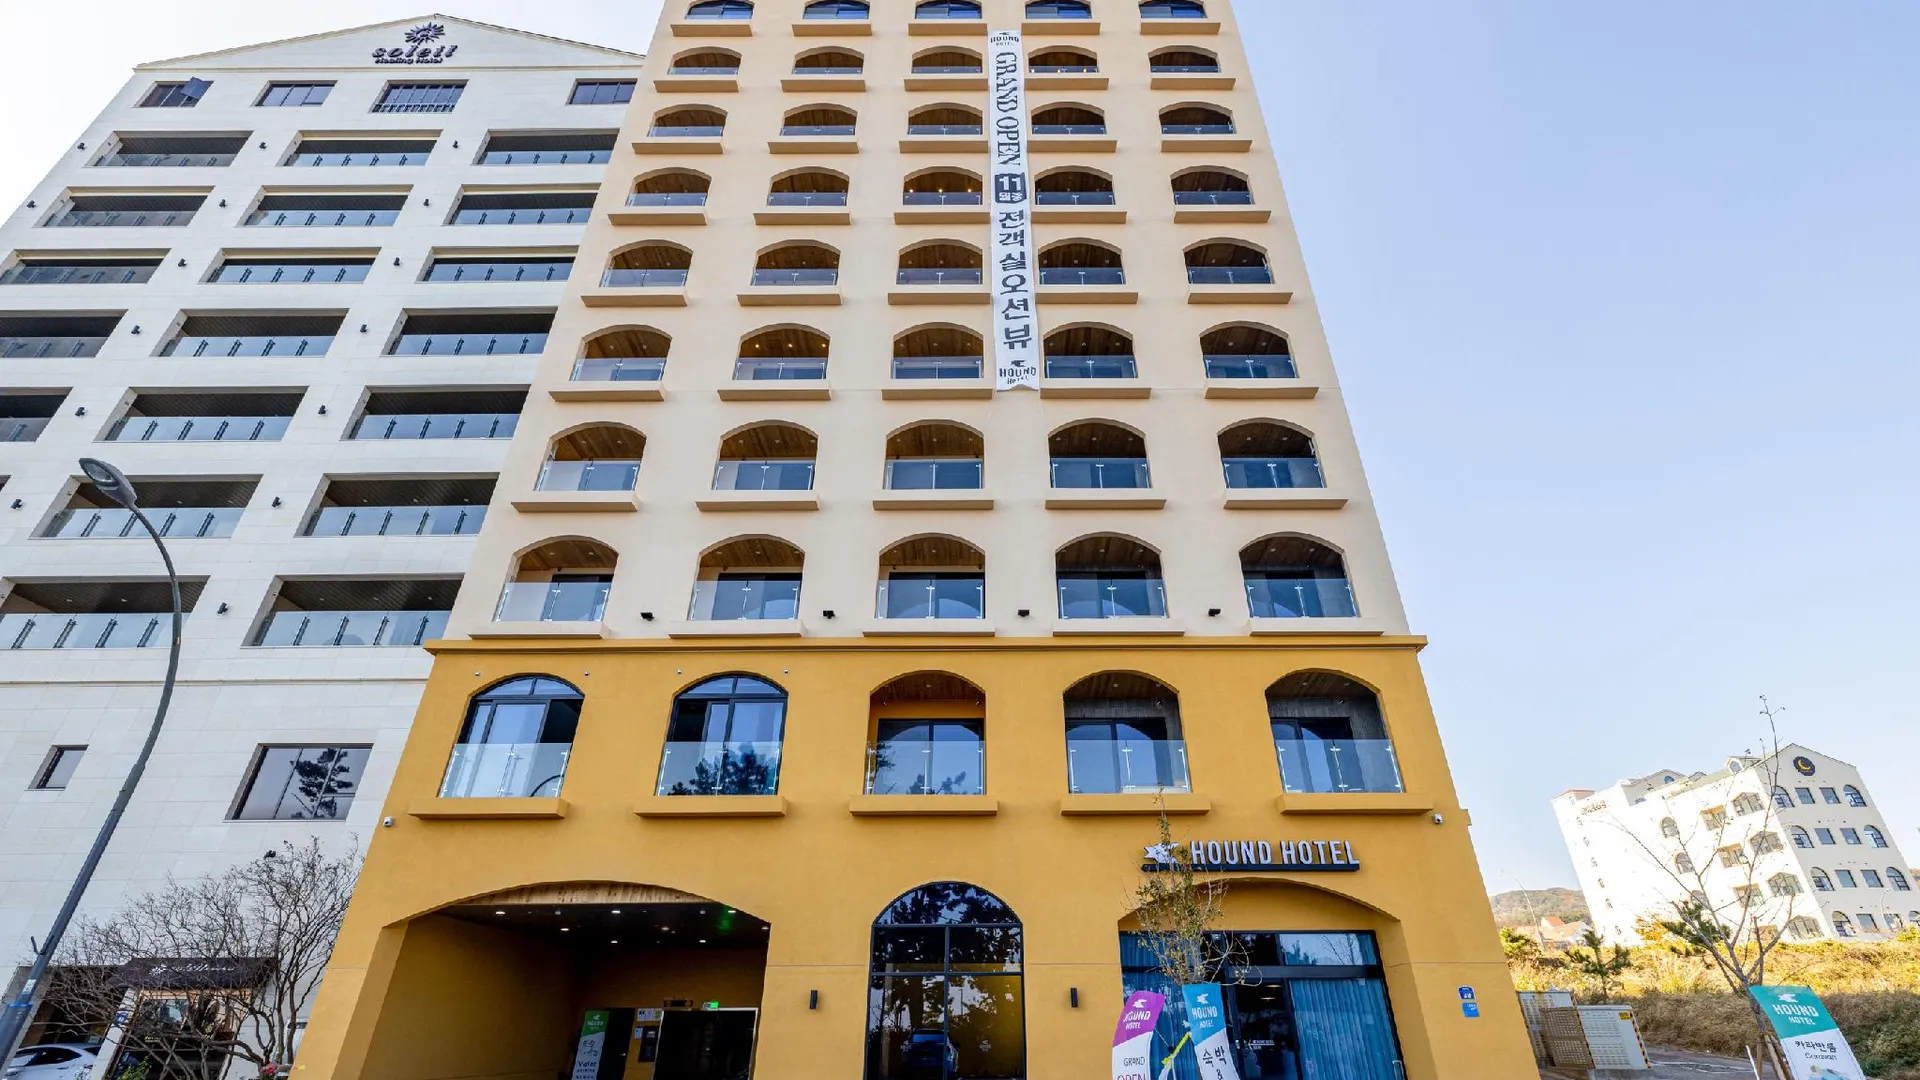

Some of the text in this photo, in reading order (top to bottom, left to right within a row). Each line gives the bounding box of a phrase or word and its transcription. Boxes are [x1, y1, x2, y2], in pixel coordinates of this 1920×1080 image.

[372, 44, 458, 58] soleil
[996, 52, 1020, 166] GRAND OPEN
[999, 176, 1022, 191] 11
[999, 366, 1037, 378] HOUND
[1190, 840, 1360, 865] HOUND HOTEL
[1123, 1010, 1151, 1023] HOUND
[1191, 1005, 1218, 1019] HOUND
[1773, 1004, 1819, 1017] HOUND
[1788, 1016, 1816, 1025] HOTEL
[1123, 1056, 1146, 1067] GRAND
[1202, 1045, 1227, 1067] 숙박
